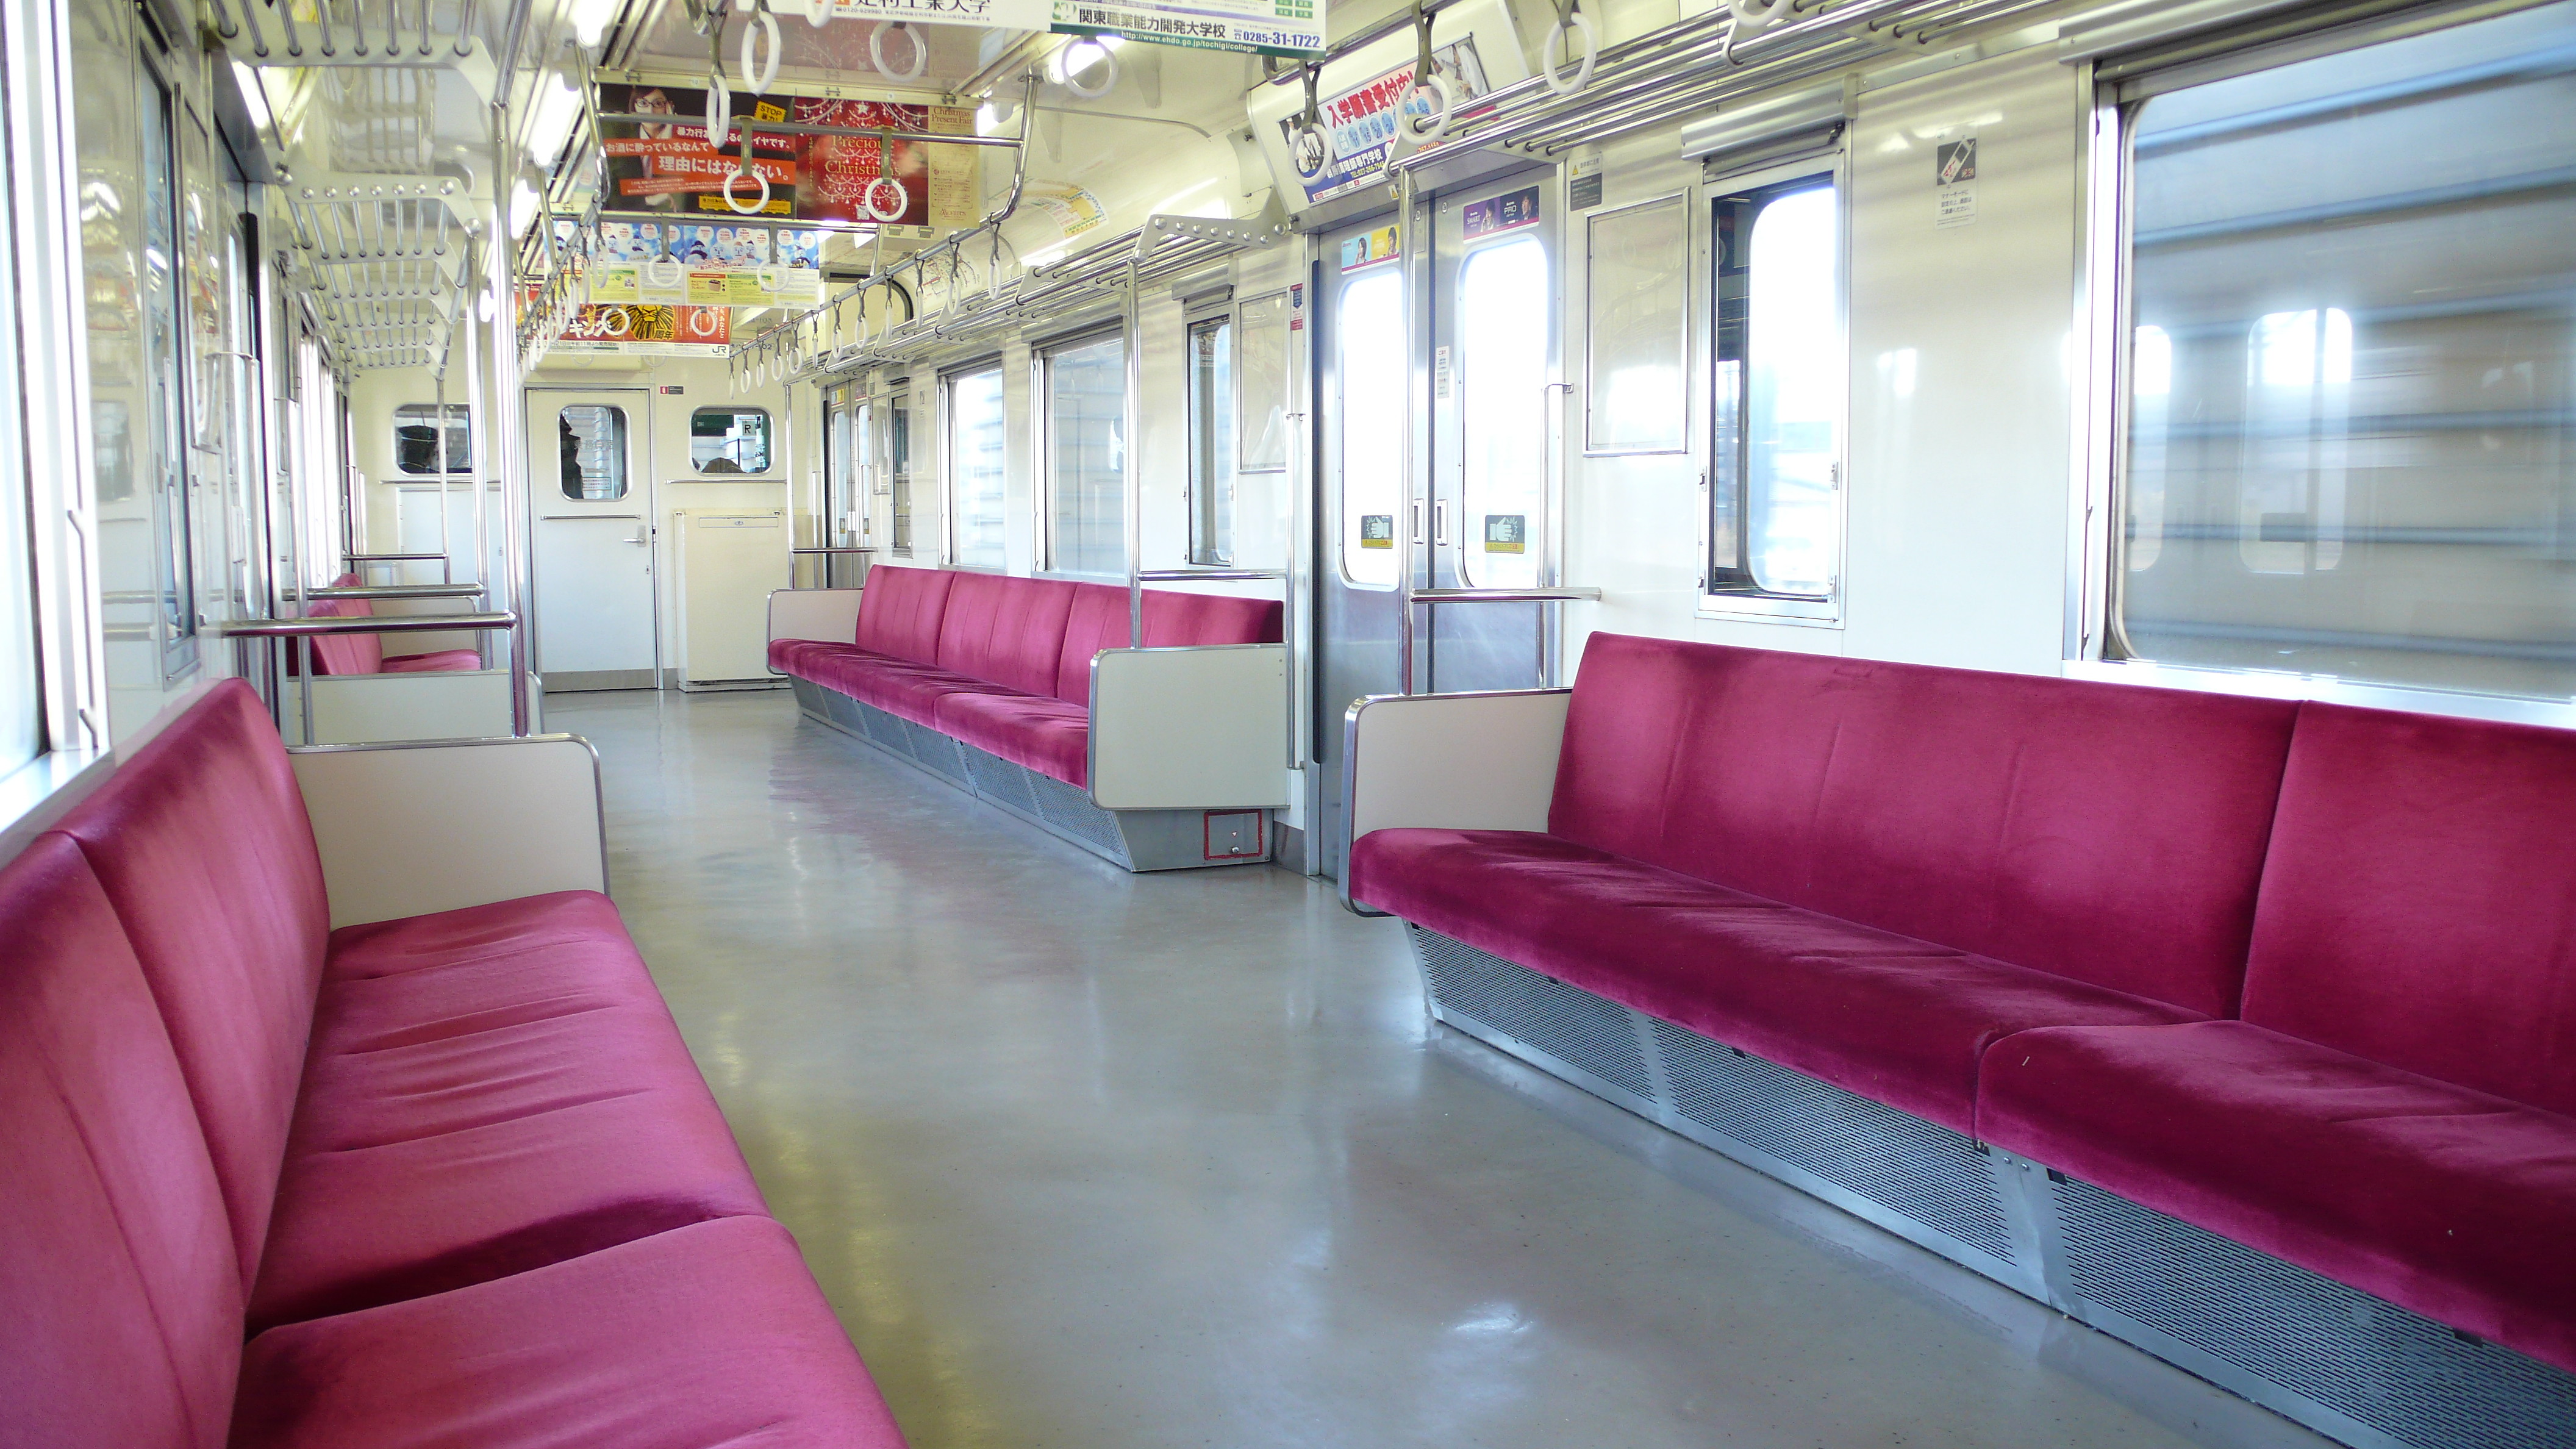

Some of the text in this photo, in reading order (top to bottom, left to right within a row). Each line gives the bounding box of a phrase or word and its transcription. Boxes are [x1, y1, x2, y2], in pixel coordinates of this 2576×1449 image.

[1079, 8, 1226, 38] 関東職業能力開発大学校
[1121, 30, 1258, 52] http://www.ehdo.go.jp/tochigi/college/
[1243, 30, 1320, 48] 0285-31-1722
[760, 104, 782, 116] STOP
[934, 107, 970, 117] Christmas
[959, 116, 973, 125] Fair
[606, 141, 709, 152] お酒に酔っているなんて
[658, 156, 789, 181] 理由にはなない。
[825, 160, 901, 176] Christms
[654, 330, 674, 340] 周年
[712, 345, 727, 354] JR
